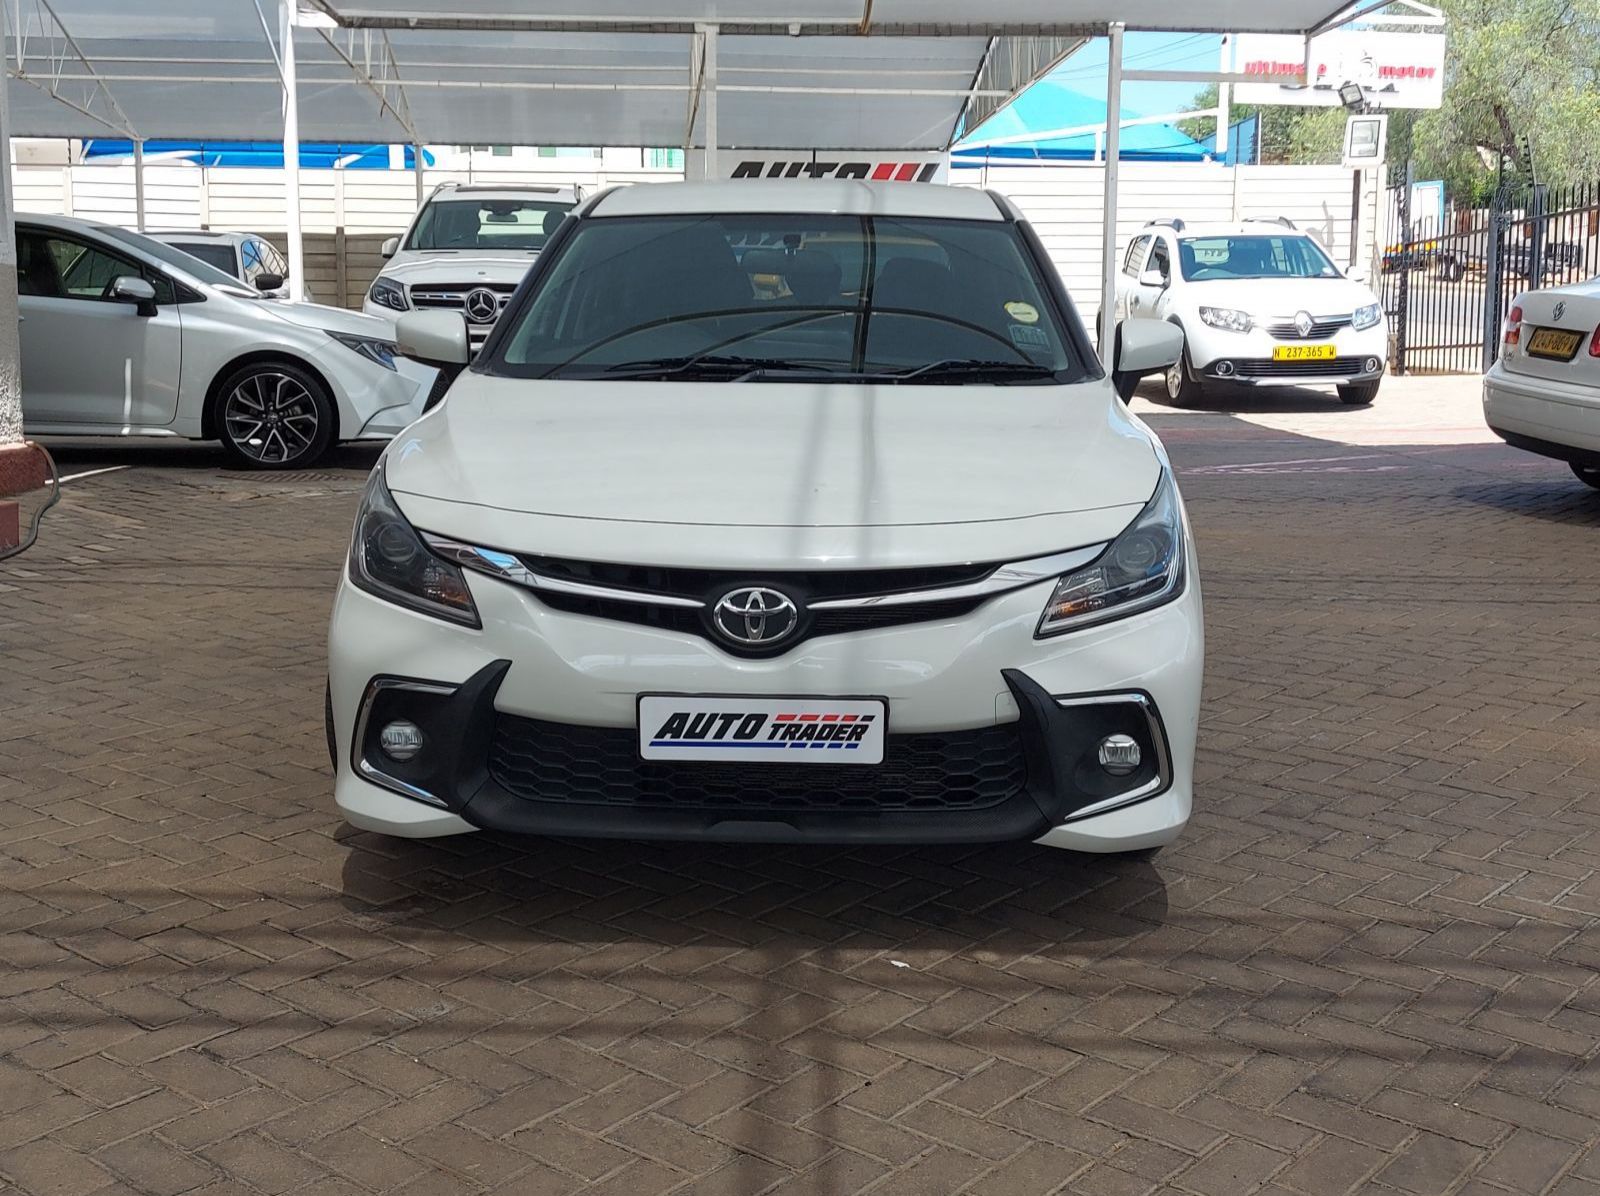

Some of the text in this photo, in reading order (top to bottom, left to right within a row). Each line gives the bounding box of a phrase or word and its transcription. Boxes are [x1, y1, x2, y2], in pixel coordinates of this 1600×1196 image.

[1286, 346, 1323, 358] 237-365
[653, 712, 869, 741] AUTO TRADER
